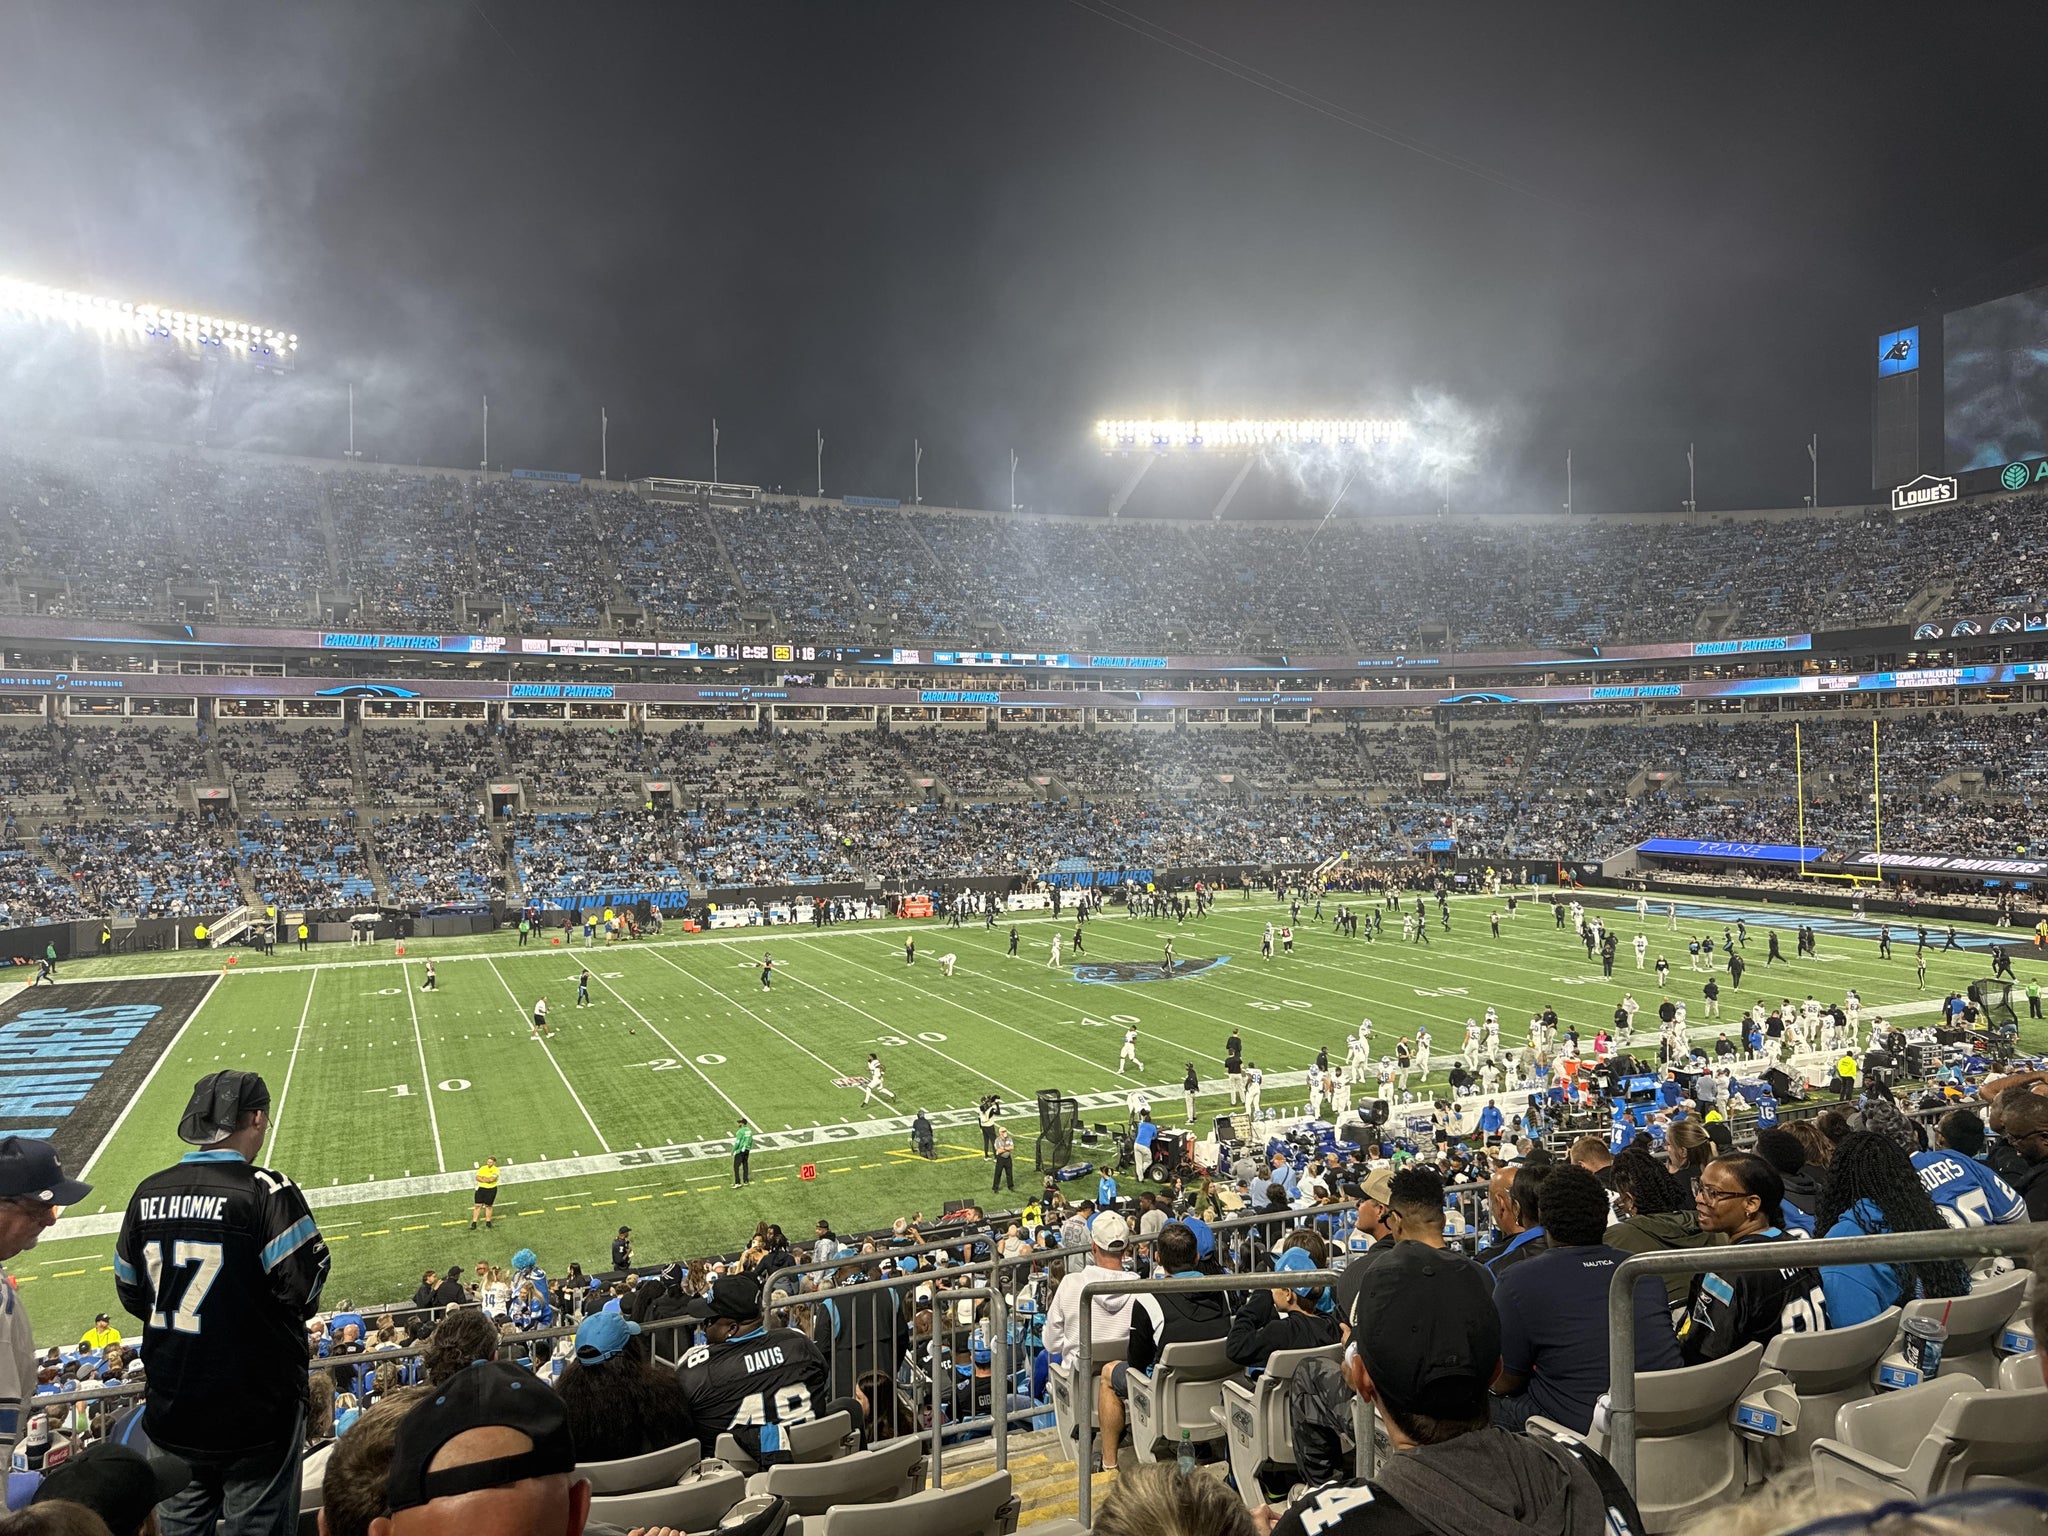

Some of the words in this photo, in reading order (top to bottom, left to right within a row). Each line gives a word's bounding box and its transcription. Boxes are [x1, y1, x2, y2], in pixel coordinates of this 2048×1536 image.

[1898, 484, 1951, 506] LOWE'S
[324, 633, 380, 648] CAROLINA
[383, 635, 440, 649] PANTHERS
[1695, 640, 1739, 655] CAROLINA
[1741, 637, 1786, 651] PANTHERS
[714, 644, 728, 658] 16
[742, 646, 768, 659] 2:52
[775, 647, 789, 658] 25
[802, 647, 815, 660] 16
[1092, 656, 1127, 667] CAROLINA
[1129, 657, 1167, 668] PANTHERS
[511, 685, 560, 697] CAROLINA
[563, 686, 613, 698] PANTHERS
[920, 691, 959, 702] CAROLINA
[960, 691, 999, 703] PANTHERS
[1592, 685, 1635, 698] CAROLINA
[1636, 684, 1682, 697] PANTHERS
[1698, 842, 1767, 854] TRANE
[1858, 851, 1948, 868] CAROLINA
[1949, 855, 2047, 875] PANTHERS
[1080, 1014, 1141, 1027] 40
[876, 1032, 948, 1047] 30
[647, 1053, 728, 1071] 20
[389, 1078, 472, 1098] 10
[1759, 1106, 1774, 1120] 16
[1611, 1129, 1623, 1145] 14
[802, 1165, 816, 1178] 20
[140, 1194, 228, 1222] DELHOMME
[1582, 1259, 1615, 1268] NAUTICA
[142, 1239, 224, 1335] 17
[485, 1294, 497, 1307] 14
[743, 1346, 785, 1374] DAVIS
[725, 1381, 816, 1432] 48
